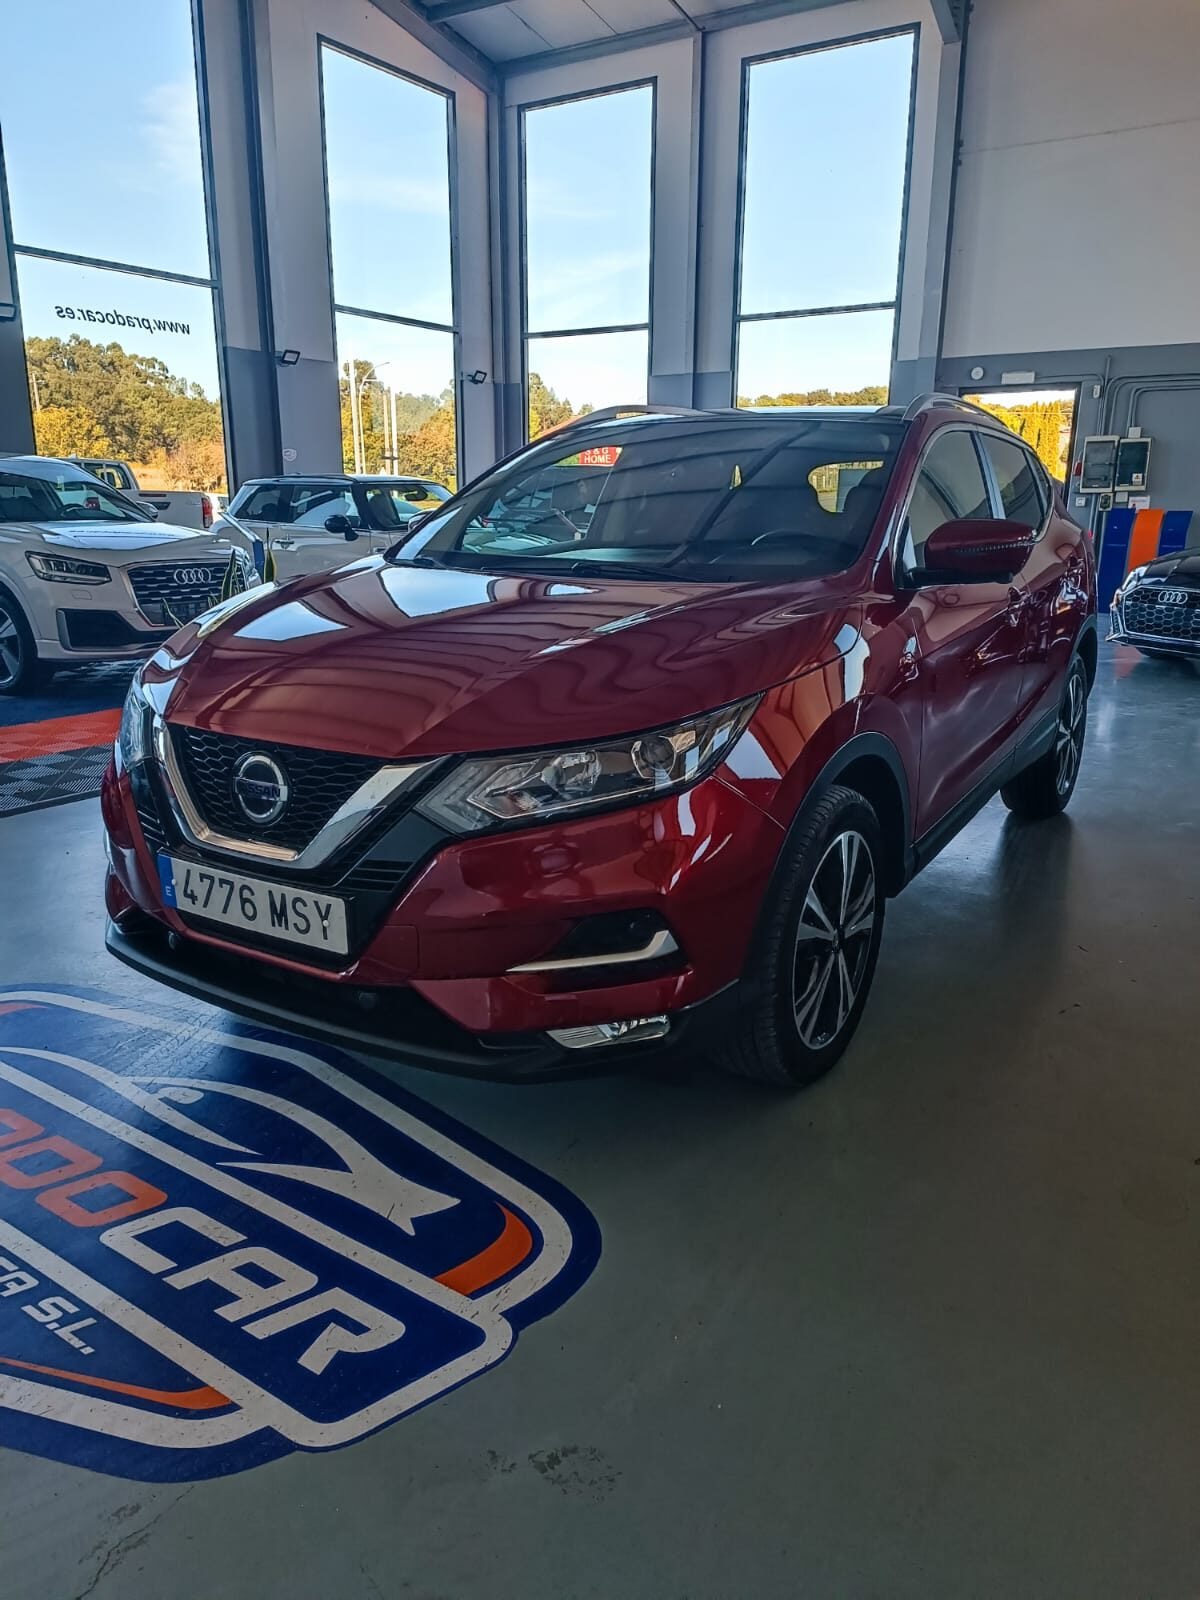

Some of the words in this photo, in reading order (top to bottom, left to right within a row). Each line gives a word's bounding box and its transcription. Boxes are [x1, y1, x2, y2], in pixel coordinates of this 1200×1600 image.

[584, 454, 612, 464] HOME
[165, 886, 172, 897] E
[183, 869, 258, 922] 4776
[268, 889, 332, 940] MSY
[20, 1296, 97, 1355] S.L.
